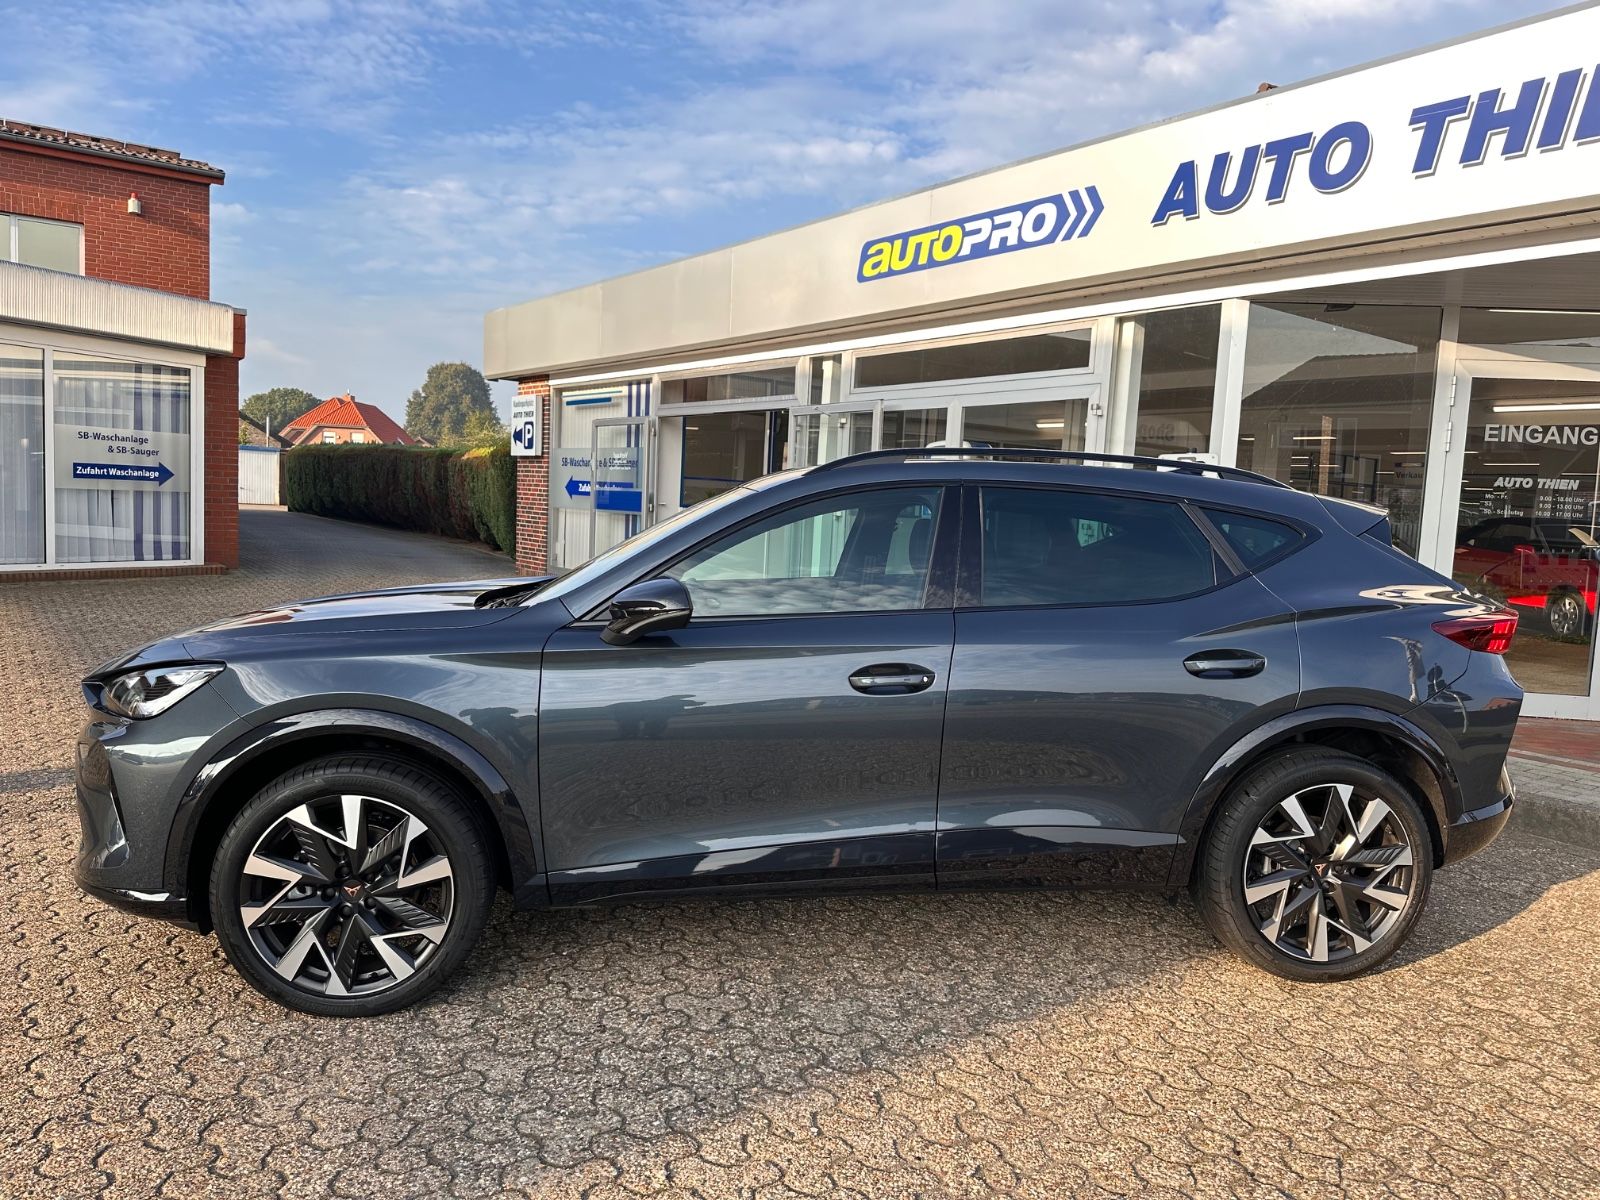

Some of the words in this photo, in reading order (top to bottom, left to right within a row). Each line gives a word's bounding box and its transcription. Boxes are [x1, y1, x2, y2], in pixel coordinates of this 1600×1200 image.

[1150, 121, 1373, 228] AUTO
[77, 431, 149, 445] SB-Waschanlage
[525, 424, 533, 447] P
[1483, 423, 1600, 445] EINGANG
[107, 445, 114, 453] &
[116, 446, 159, 457] SB-Sauger
[76, 466, 107, 476] Zufahrt
[108, 468, 159, 479] Waschanlage
[1493, 476, 1533, 489] AUTO
[1537, 478, 1580, 491] THIEN
